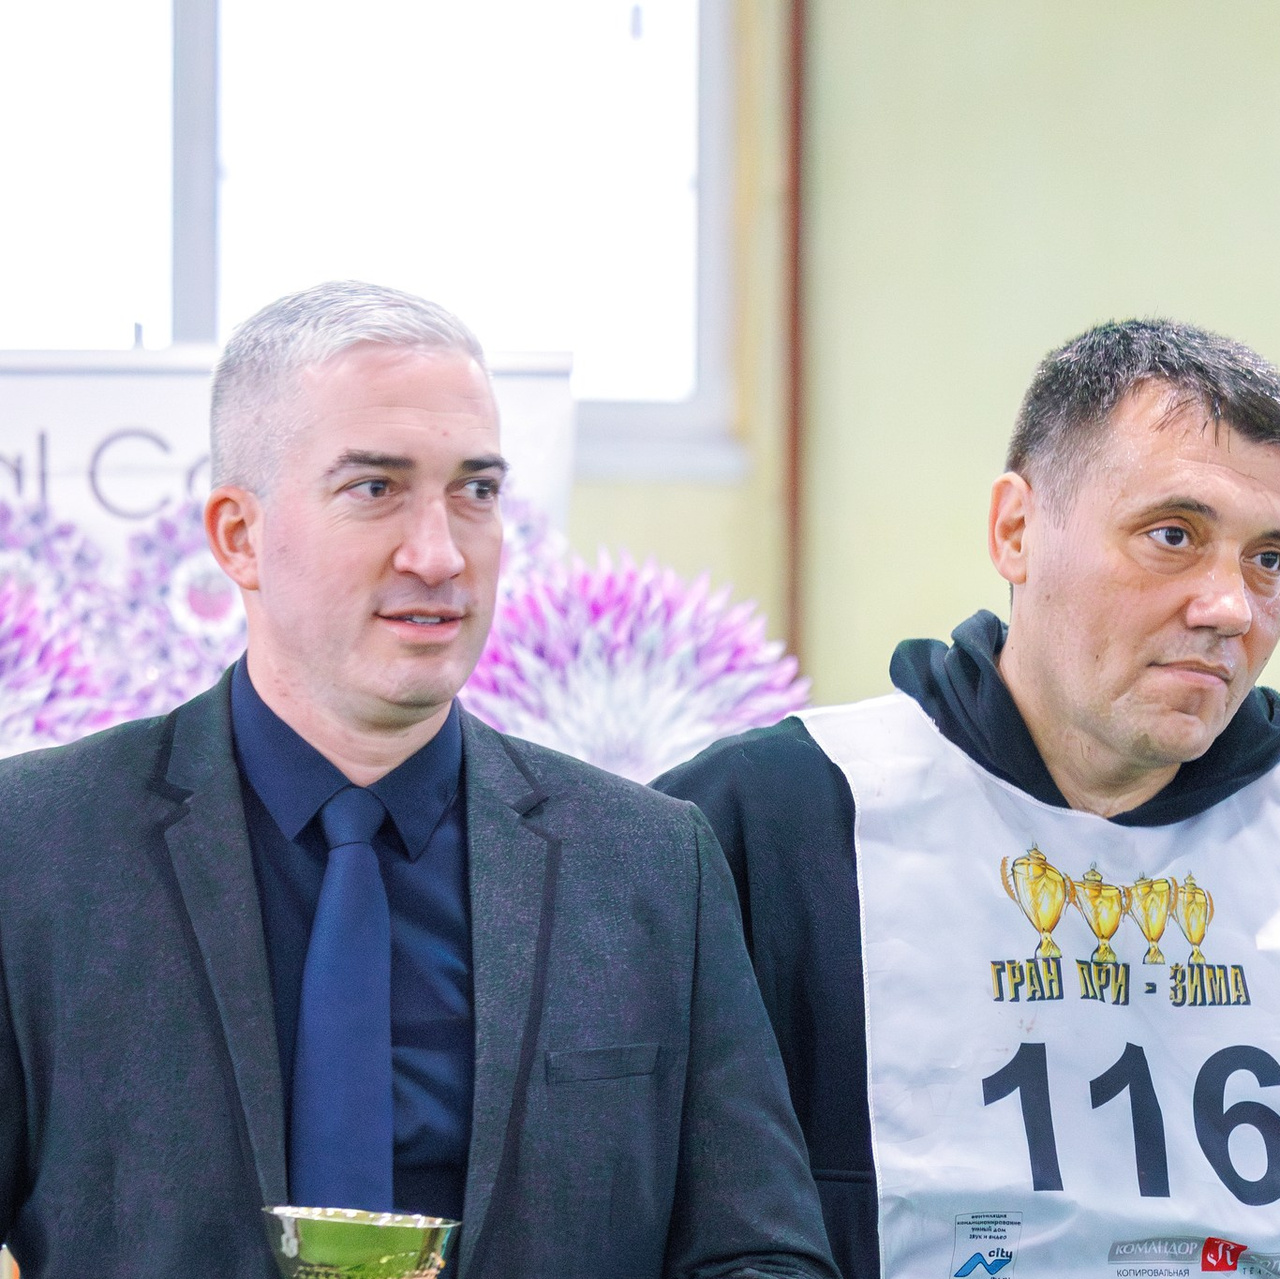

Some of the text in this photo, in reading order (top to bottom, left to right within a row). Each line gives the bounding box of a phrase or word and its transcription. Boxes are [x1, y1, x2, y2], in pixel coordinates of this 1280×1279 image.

[990, 957, 1065, 1002] ГРАН
[1075, 958, 1131, 1006] ПРИ
[1169, 962, 1252, 1007] ЗИМА
[988, 1247, 1013, 1260] city
[1115, 1240, 1198, 1256] КОМАНДОР
[1116, 1268, 1190, 1278] КОПИРОВАЛЬНАЯ
